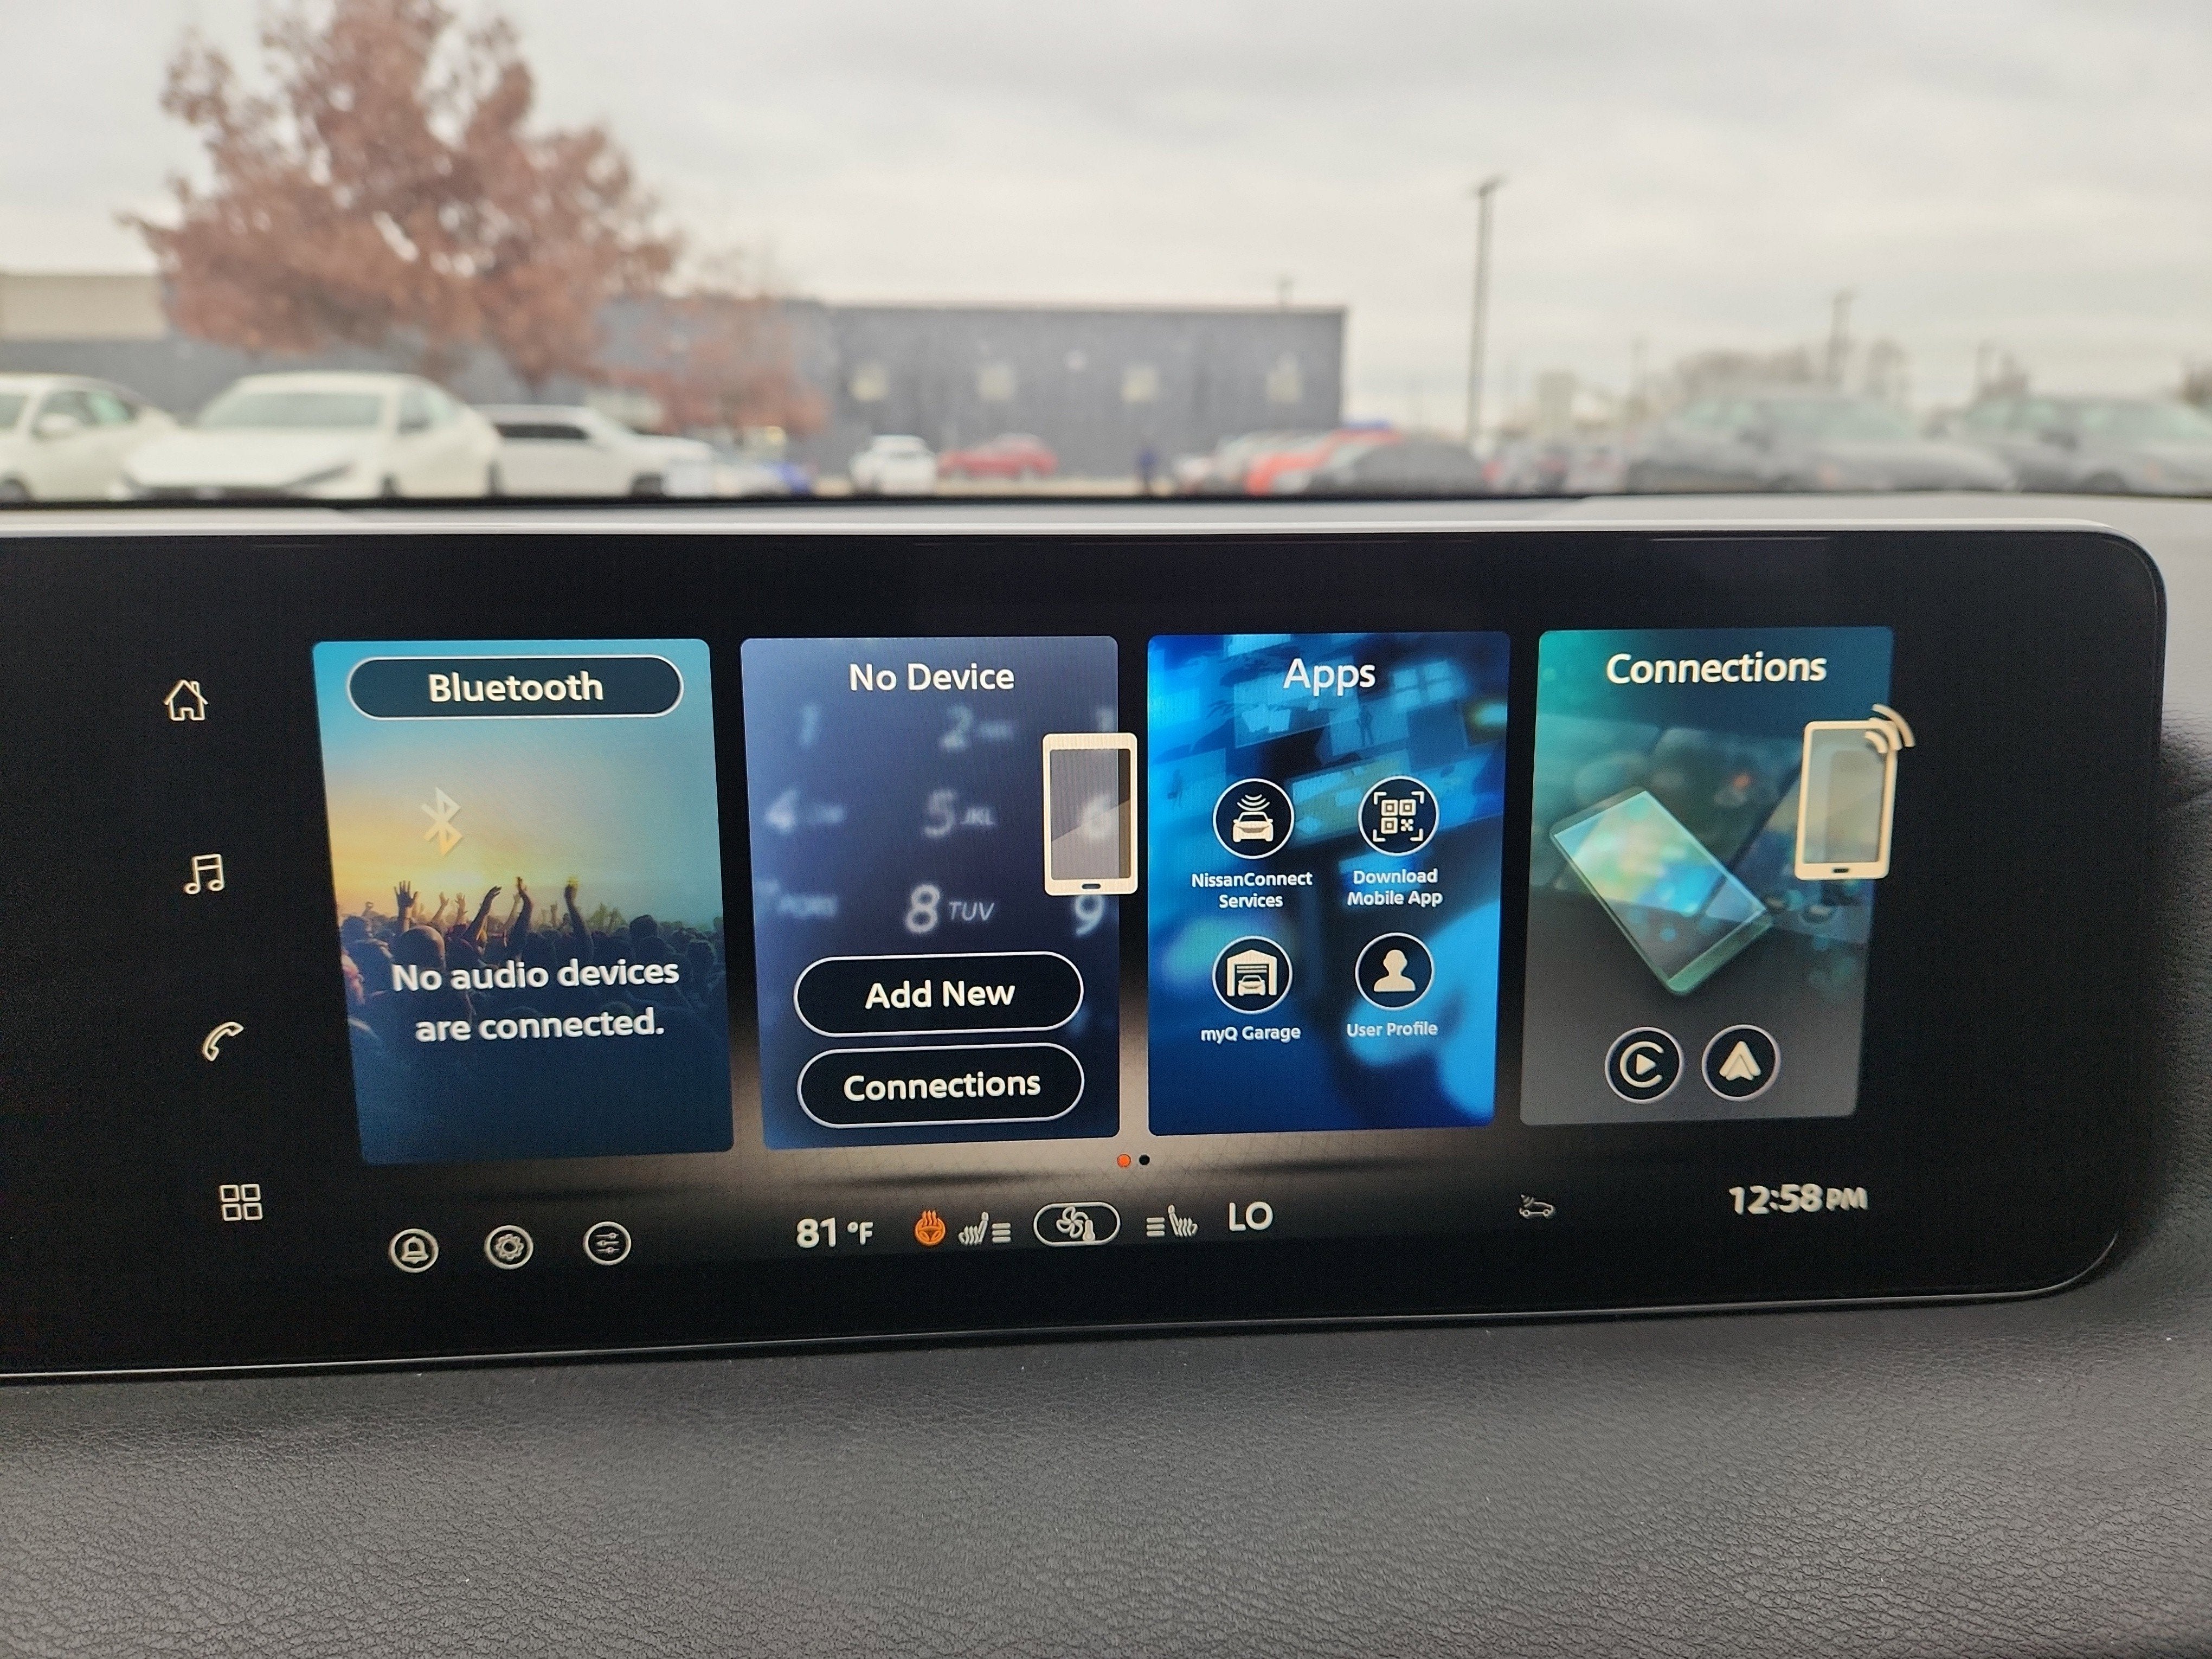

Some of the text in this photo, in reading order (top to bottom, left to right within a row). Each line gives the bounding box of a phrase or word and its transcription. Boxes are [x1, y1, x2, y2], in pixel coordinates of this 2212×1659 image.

[849, 663, 1015, 691] No Device
[1283, 658, 1376, 696] Apps
[1606, 651, 1827, 684] Connections
[428, 671, 604, 702] Bluetooth
[939, 705, 974, 752] 2
[923, 788, 956, 838] 5
[1192, 872, 1313, 888] NissanConnect
[1353, 869, 1438, 885] Download
[905, 884, 995, 934] 8 TUV
[1219, 893, 1283, 908] Services
[1347, 890, 1443, 908] Mobile App
[1075, 895, 1105, 936] 9
[392, 958, 679, 992] No audio devices
[865, 980, 1015, 1009] Add New
[415, 1007, 665, 1041] are connected.
[1200, 1026, 1301, 1045] myQ Garage
[1347, 1022, 1438, 1038] User Profile
[843, 1072, 1041, 1102] Connections
[1729, 1184, 1868, 1214] 12:58 PM
[1228, 1202, 1274, 1232] LO
[796, 1218, 836, 1248] 81
